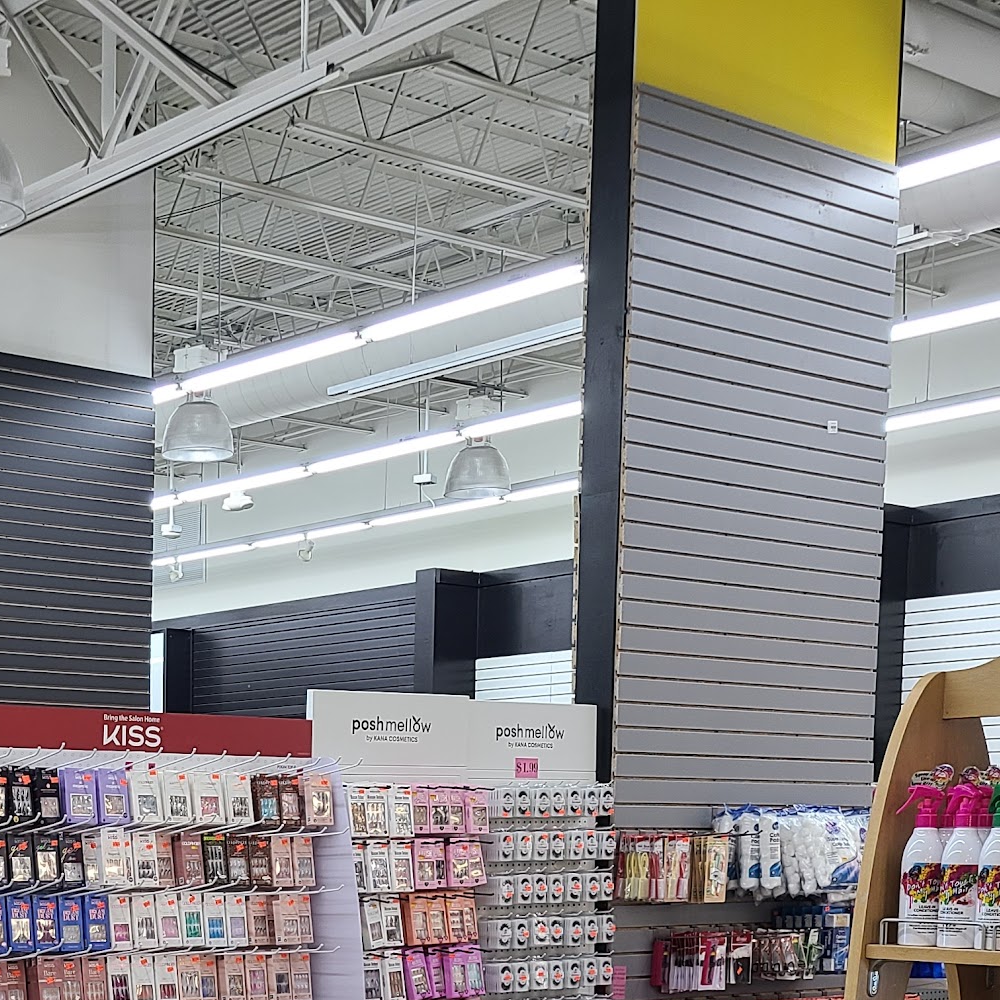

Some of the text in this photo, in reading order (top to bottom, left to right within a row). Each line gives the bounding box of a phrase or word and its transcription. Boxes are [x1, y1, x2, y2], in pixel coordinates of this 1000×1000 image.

[104, 714, 118, 722] Bring
[352, 715, 431, 734] poshmellow
[103, 724, 161, 747] KISS
[496, 723, 564, 741] poshmellow
[516, 761, 538, 774] $1.99
